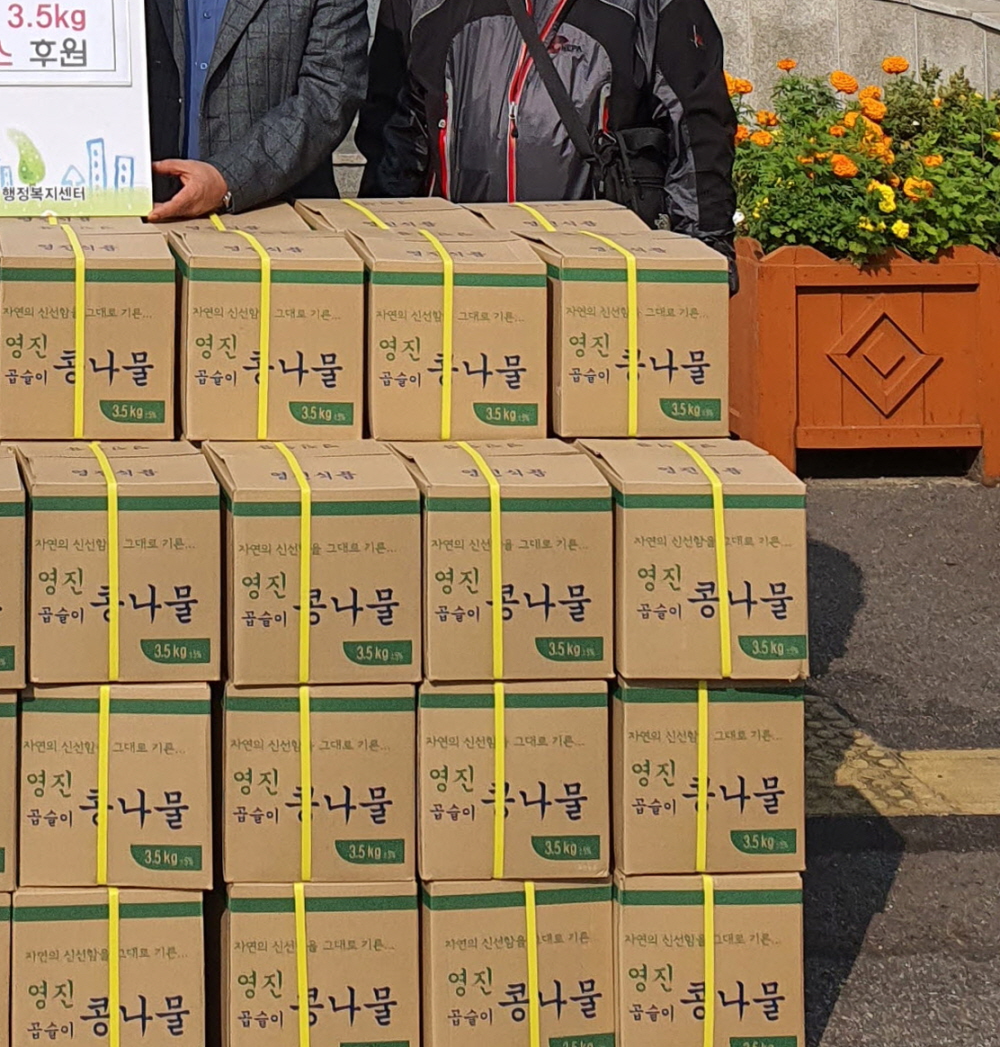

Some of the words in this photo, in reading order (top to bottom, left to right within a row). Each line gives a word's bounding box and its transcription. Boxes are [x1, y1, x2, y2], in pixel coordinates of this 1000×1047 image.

[8, 4, 85, 31] 3.5kg
[30, 38, 87, 67] 후원
[1, 185, 87, 203] 행정복지센터
[192, 306, 224, 319] 자연의
[274, 307, 304, 319] 그대로
[6, 333, 47, 358] 영진
[196, 334, 236, 359] 영진
[380, 336, 420, 361] 영진
[570, 333, 608, 357] 영진
[5, 369, 47, 385] 곱슬이
[569, 368, 609, 384] 곱슬이
[34, 538, 68, 551] 자연의
[123, 538, 157, 551] 그대로
[39, 568, 82, 595] 영진
[242, 572, 285, 599] 영진
[435, 567, 478, 594] 영진
[638, 564, 680, 591] 영진
[242, 611, 286, 627] 곱슬이
[293, 587, 399, 626] 콩나물
[435, 606, 479, 622] 곱슬이
[486, 583, 591, 622] 콩나물
[637, 604, 681, 620] 곱슬이
[687, 581, 793, 620] 콩나물
[38, 607, 83, 624] 곱슬이
[27, 770, 71, 798] 영진
[234, 768, 277, 795] 영진
[430, 765, 473, 792] 영진
[632, 759, 675, 787] 영진
[27, 809, 72, 827] 곱슬이
[233, 807, 278, 824] 곱슬이
[430, 804, 474, 821] 곱슬이
[632, 798, 675, 815] 곱슬이
[238, 970, 282, 999] 영진
[449, 967, 491, 997] 영진
[629, 964, 672, 992] 영진
[29, 979, 73, 1009] 영진
[448, 1008, 492, 1026] 곱슬이
[498, 979, 602, 1022] 콩나물
[629, 1004, 673, 1022] 곱슬이
[680, 981, 785, 1021] 콩나물
[27, 1022, 73, 1039] 곱슬이
[80, 995, 190, 1036] 콩나물
[238, 1011, 283, 1028] 곱슬이
